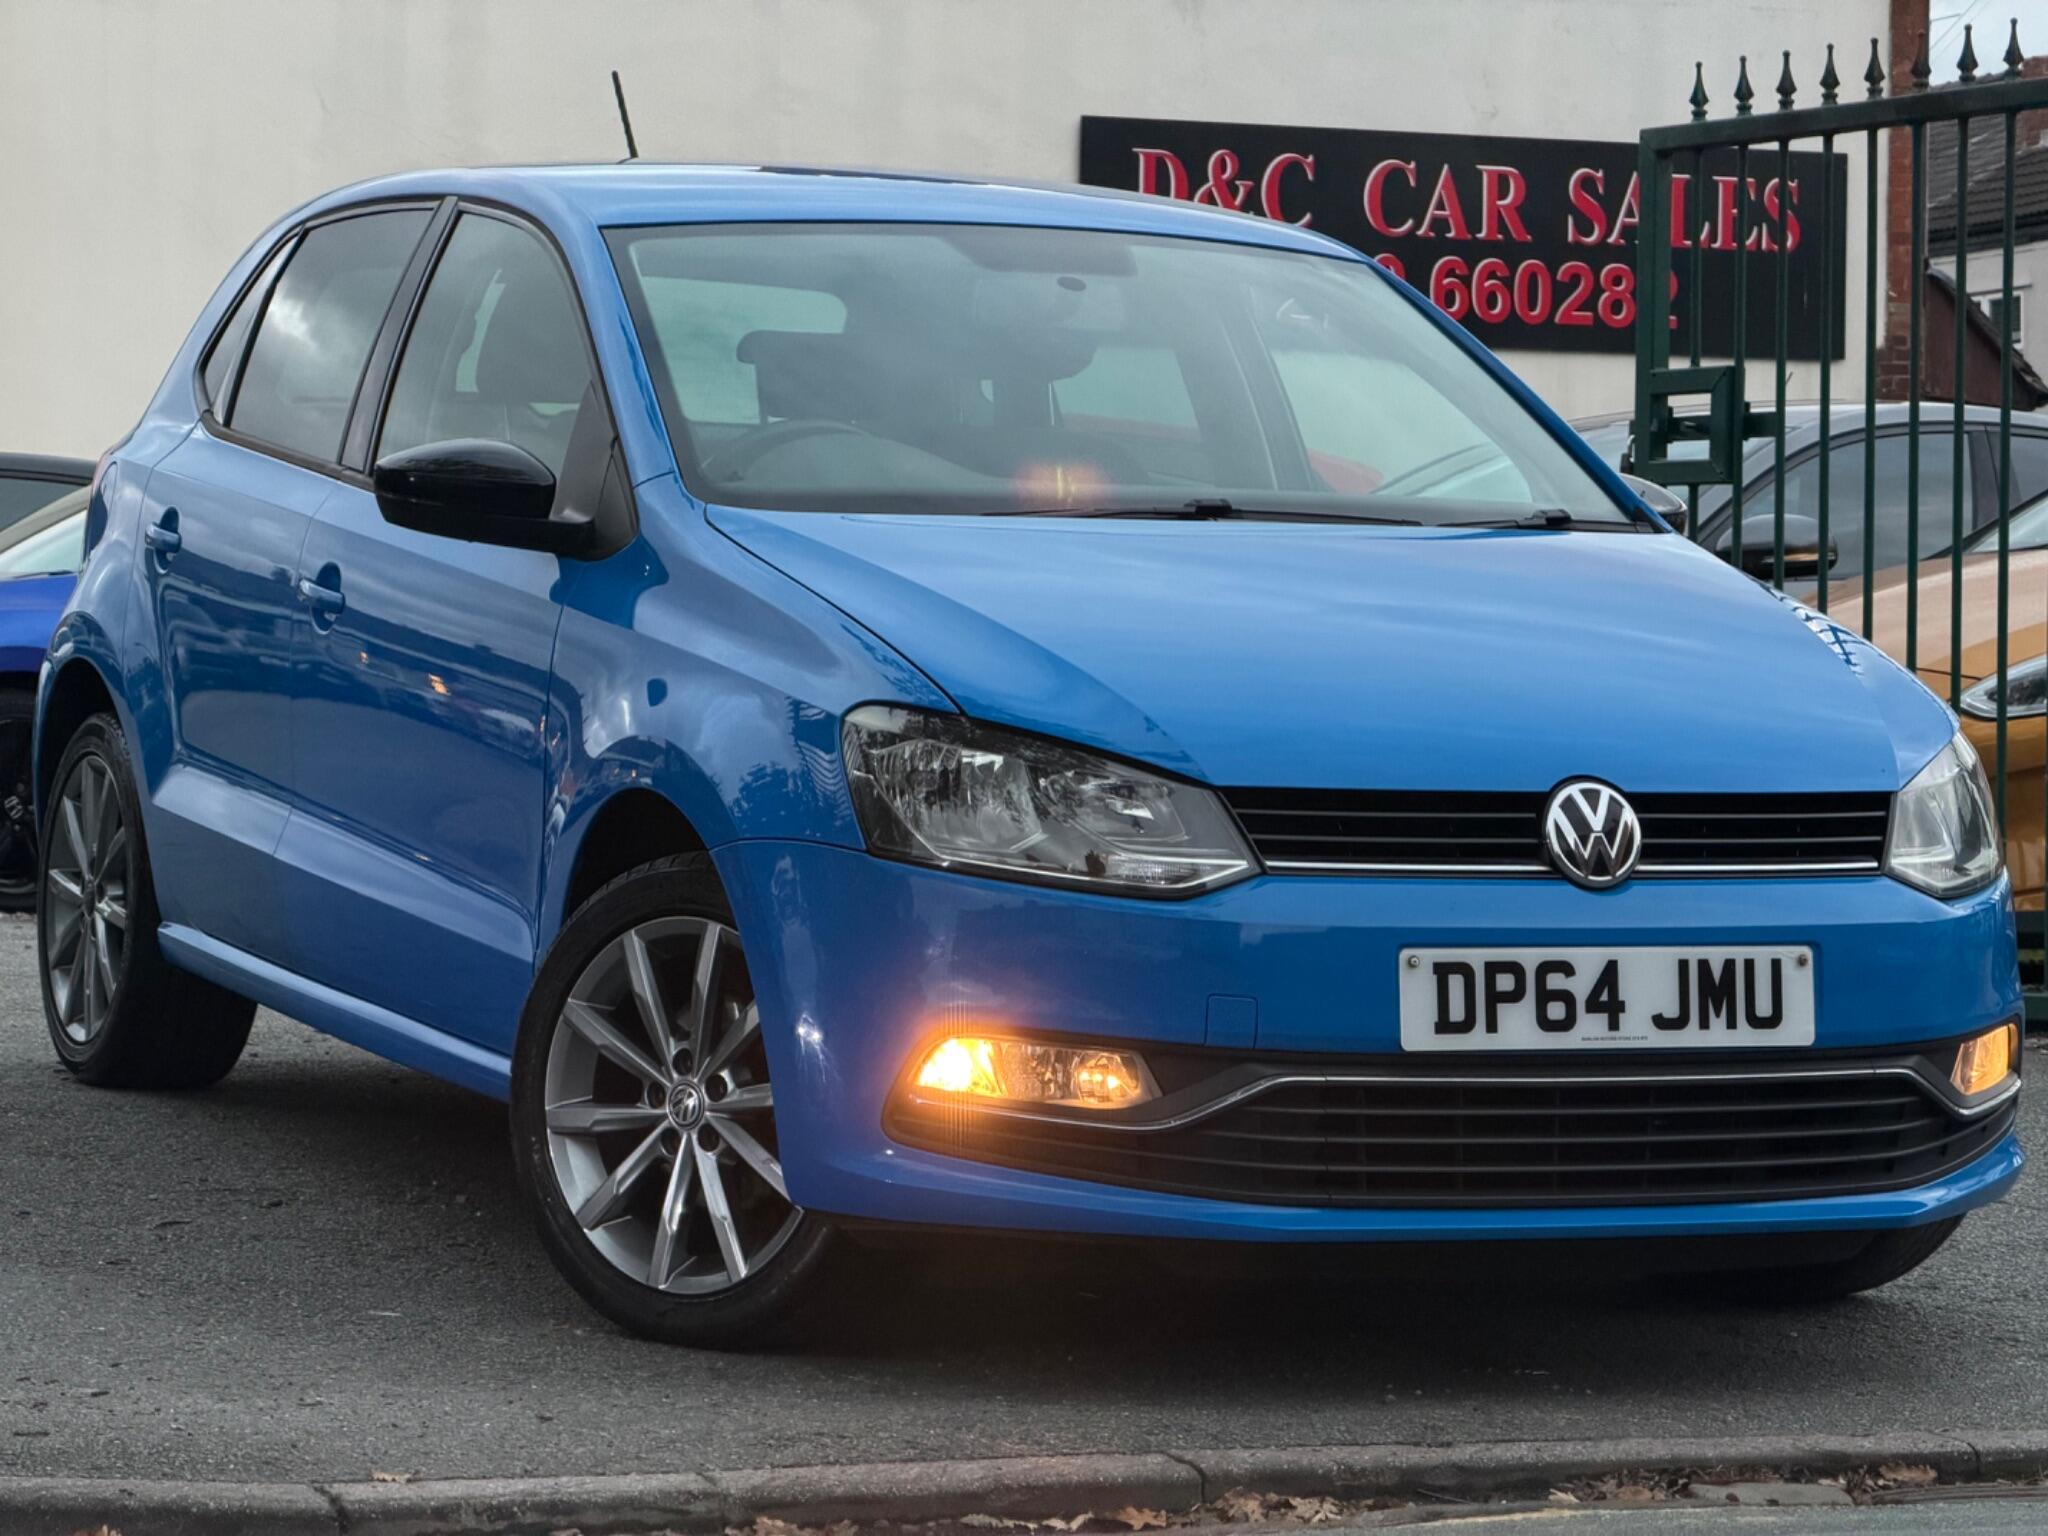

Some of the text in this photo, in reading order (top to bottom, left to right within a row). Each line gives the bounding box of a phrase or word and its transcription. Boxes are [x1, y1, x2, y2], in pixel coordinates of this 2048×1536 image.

[1132, 148, 1315, 229] D&C
[1363, 158, 1533, 242] CAR
[1432, 957, 1783, 1035] DP64 JMU
